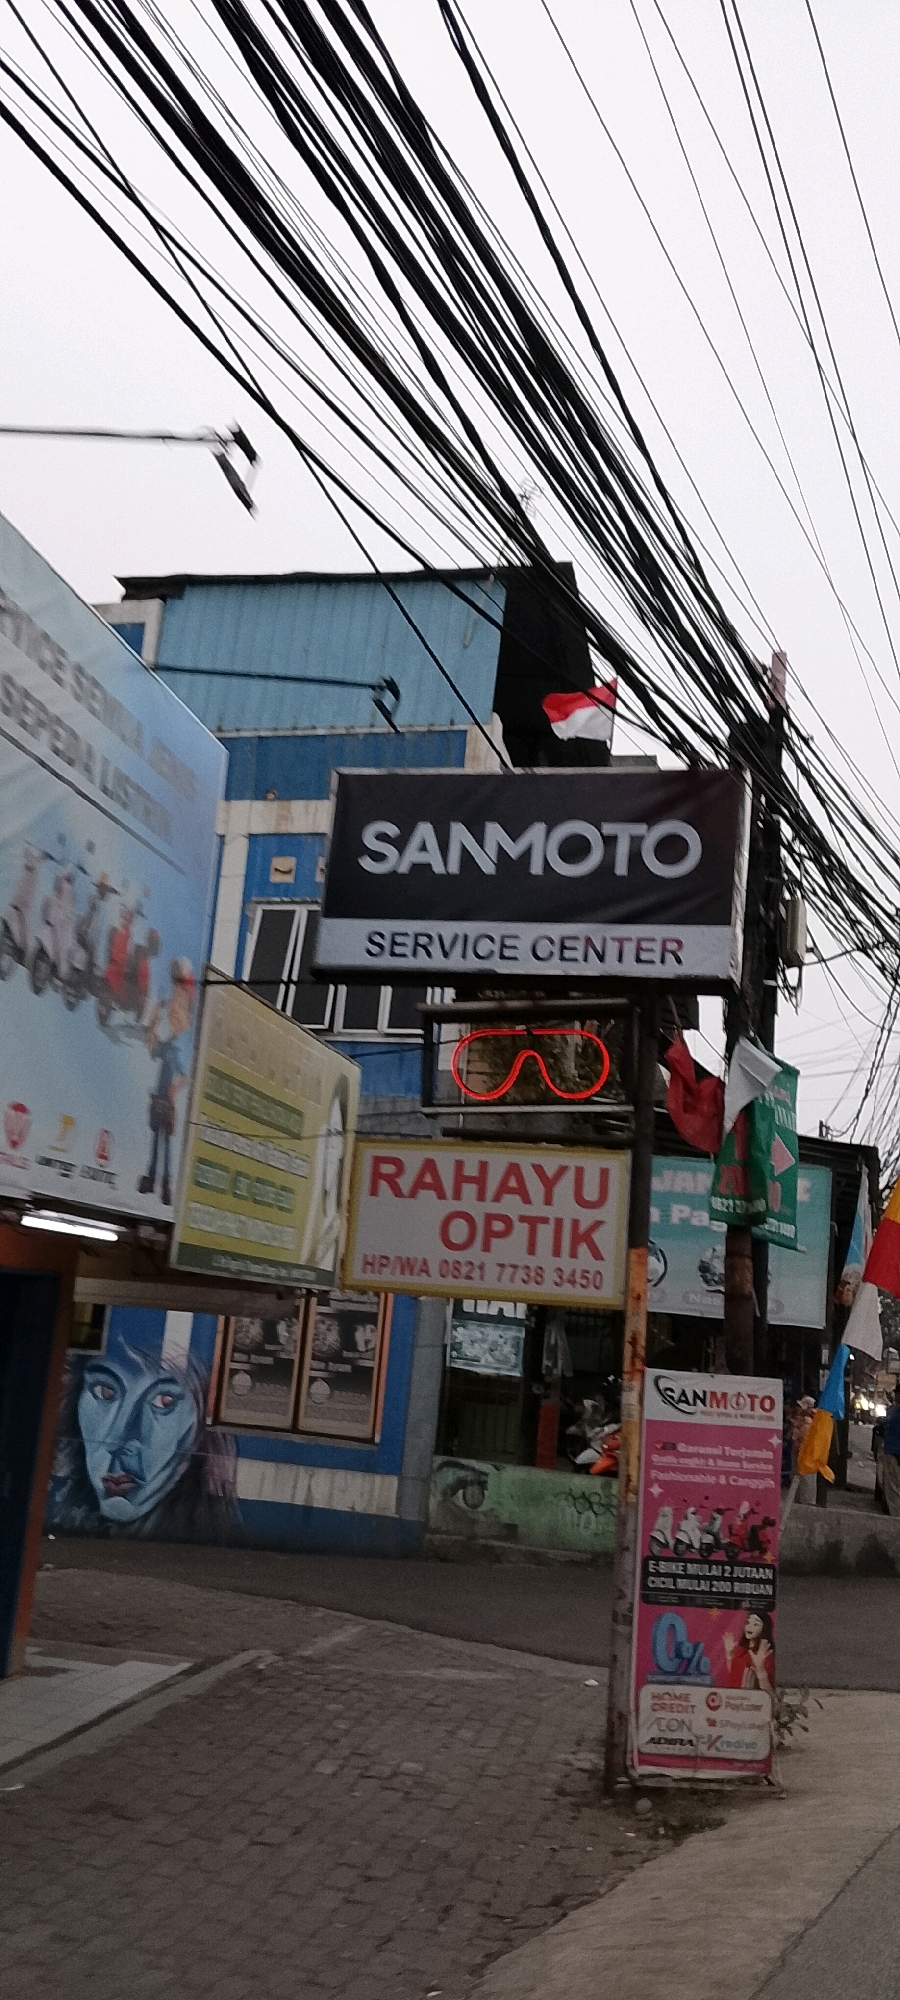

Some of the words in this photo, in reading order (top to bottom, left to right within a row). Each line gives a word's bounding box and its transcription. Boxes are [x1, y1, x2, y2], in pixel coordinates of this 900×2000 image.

[357, 819, 702, 879] SANMOTO
[366, 930, 519, 962] SERVICE
[531, 932, 685, 966] CENTER
[369, 1155, 610, 1210] RAHAYU
[439, 1210, 606, 1261] OPTIK
[361, 1253, 432, 1278] HP/WA
[438, 1258, 487, 1282] 0821
[495, 1262, 545, 1287] 7738
[553, 1266, 604, 1290] 3450
[648, 1560, 686, 1575] E-BIKE
[686, 1563, 722, 1577] MULAI
[723, 1565, 732, 1577] 2
[732, 1566, 774, 1580] JUTAAN
[733, 1582, 773, 1596] RIBUAN
